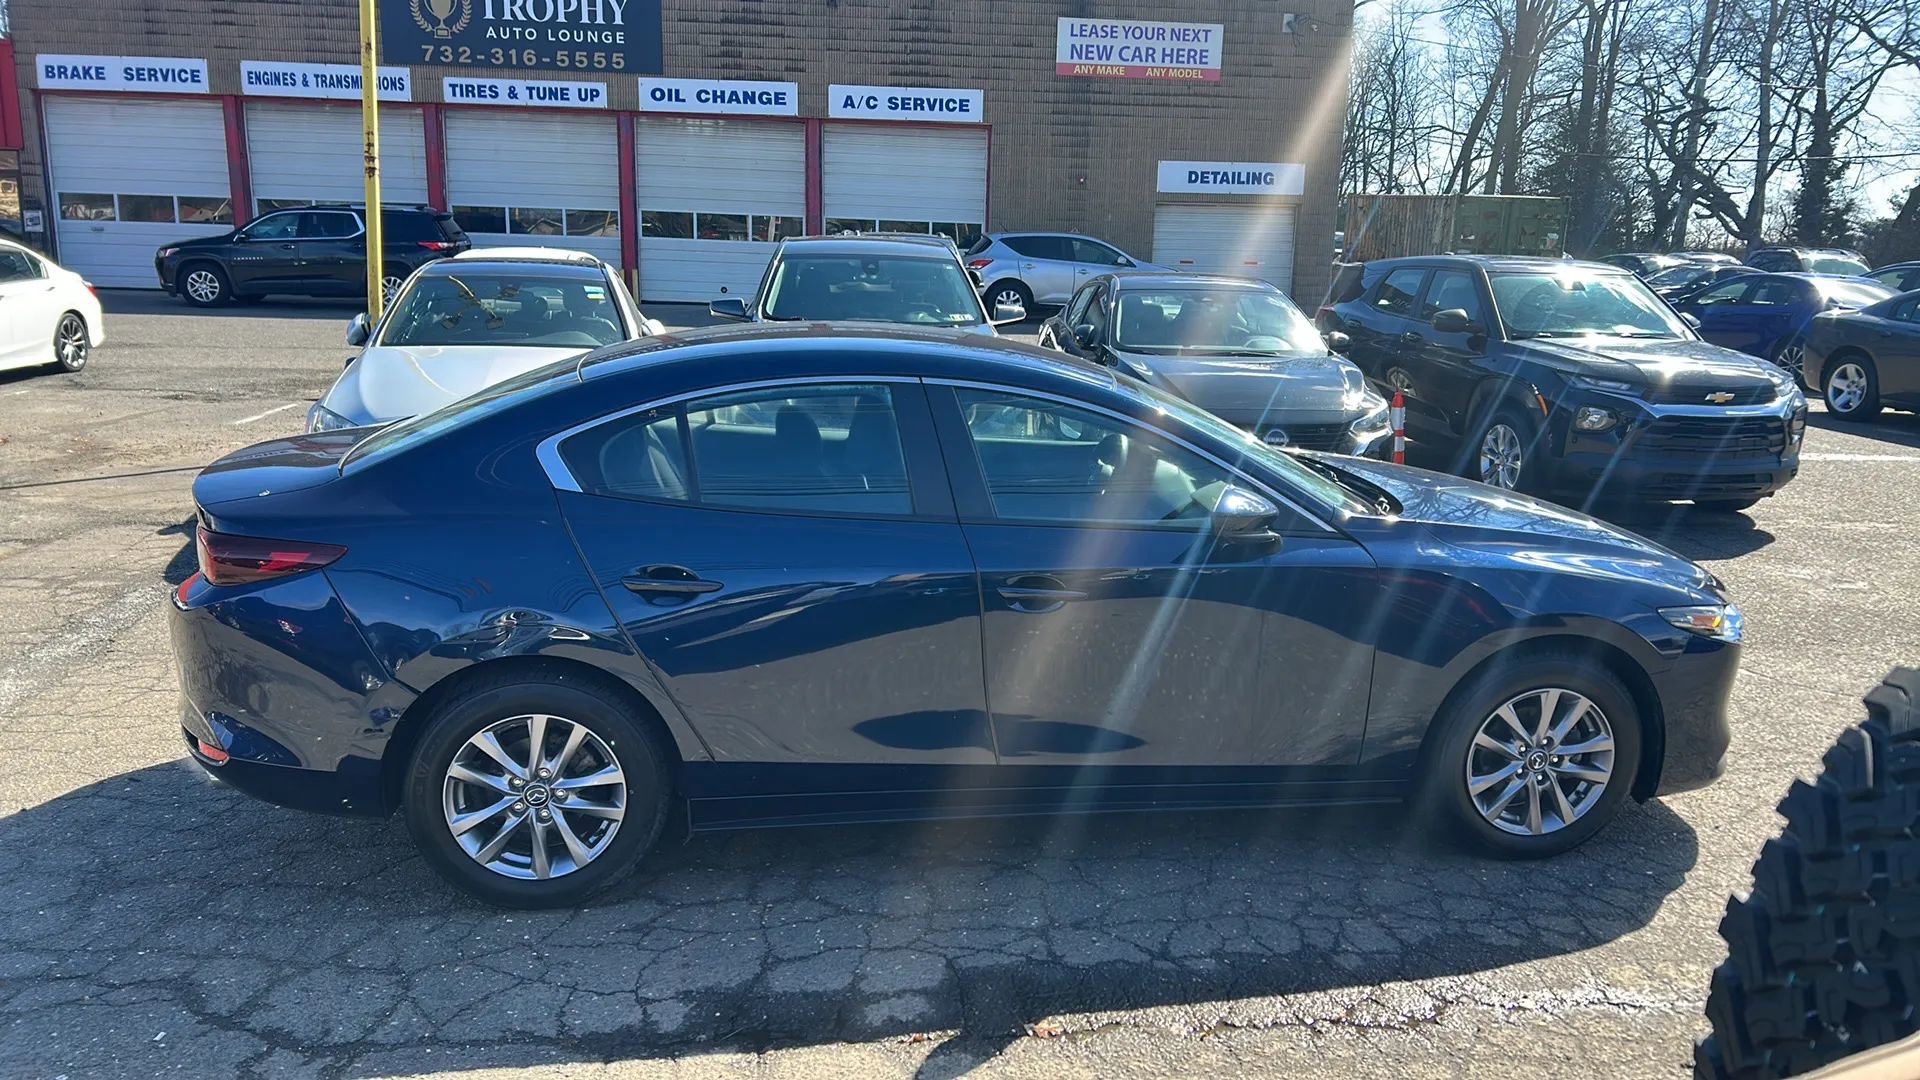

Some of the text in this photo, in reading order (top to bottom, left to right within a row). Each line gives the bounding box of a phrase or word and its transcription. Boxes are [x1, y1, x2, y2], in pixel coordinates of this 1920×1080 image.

[486, 26, 625, 44] AUTO LOUNGE
[1070, 23, 1212, 43] LEASE YOUR NEXT
[421, 45, 625, 69] 732-316-5555
[1070, 43, 1209, 65] NEW CAR HERE
[44, 65, 202, 83] BRAKE SERVICE
[246, 70, 405, 91] ENGINES & TRANSMIIONS
[1073, 65, 1204, 79] ANY MAKE ANY MODEL
[448, 83, 601, 102] TIRES & TUNE UP
[650, 87, 788, 106] OIL CHANGE
[842, 95, 971, 113] A/C SERVICE
[1187, 170, 1275, 185] DETAILING
